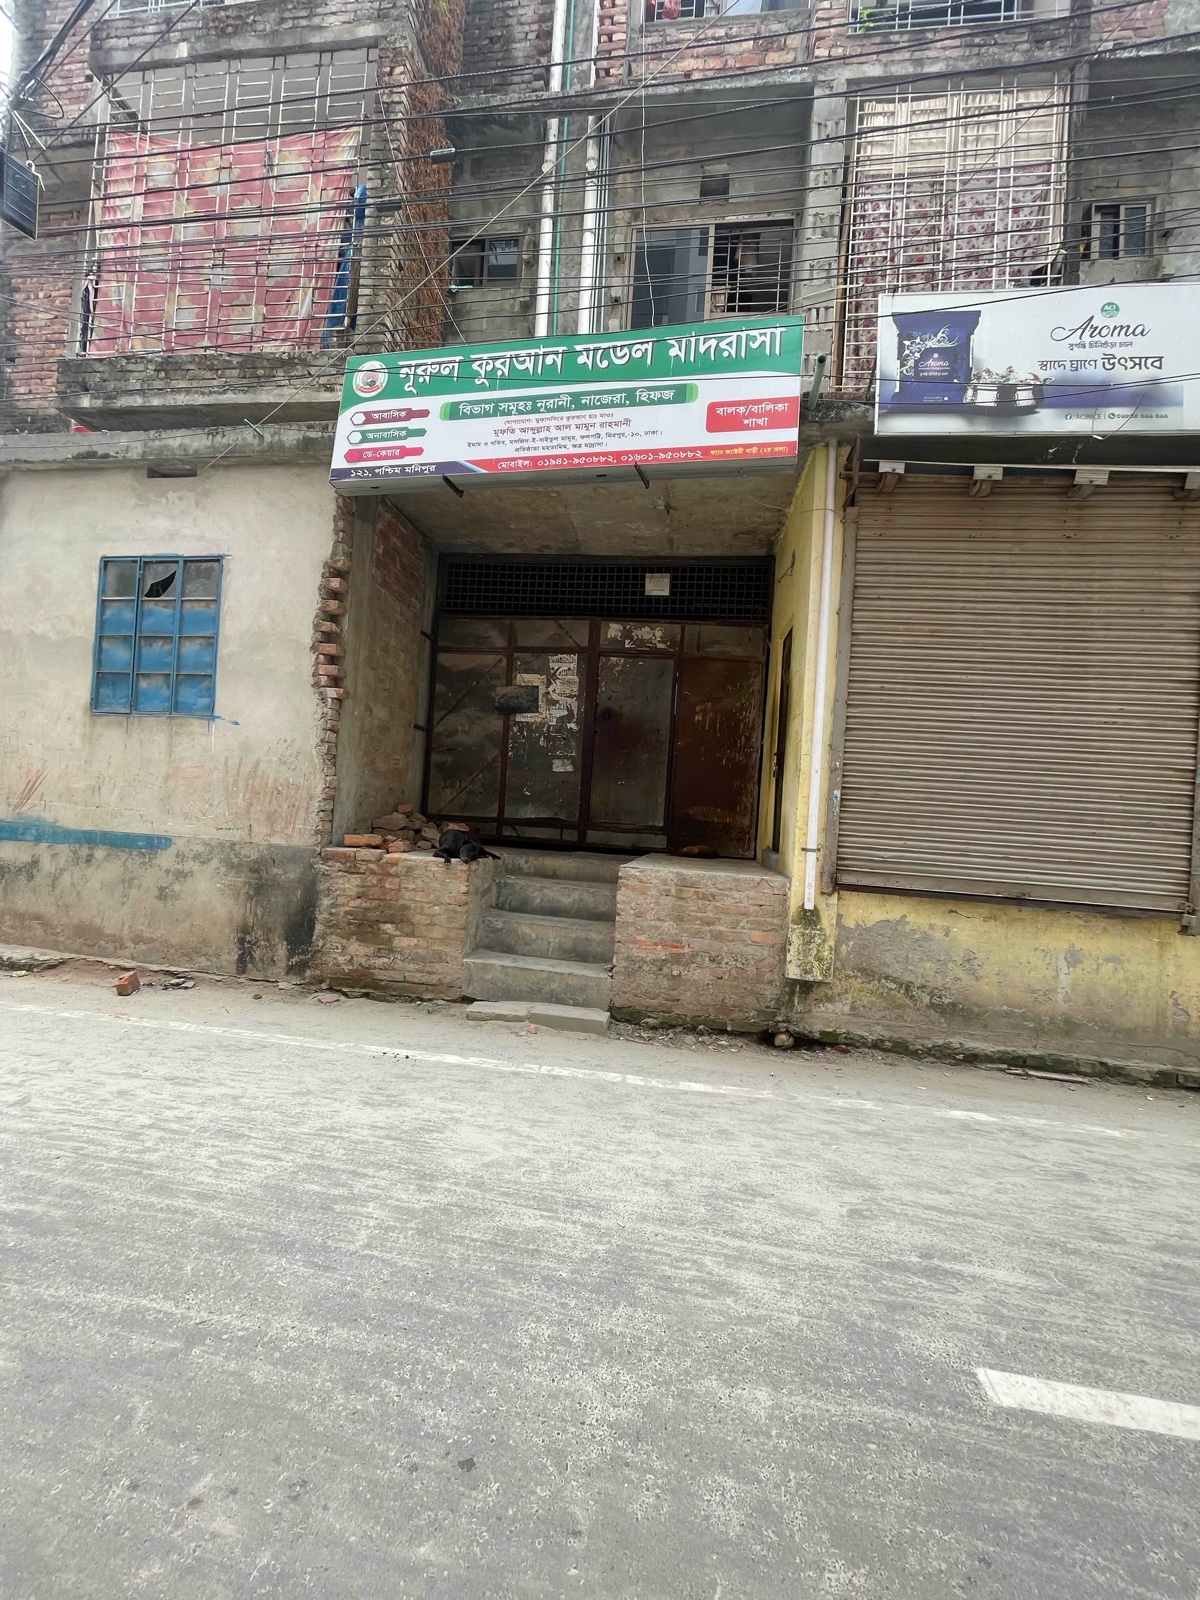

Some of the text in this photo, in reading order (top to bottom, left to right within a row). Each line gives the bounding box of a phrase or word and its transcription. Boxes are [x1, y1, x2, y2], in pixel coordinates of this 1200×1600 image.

[1050, 315, 1151, 341] Aroma
[397, 324, 787, 394] নূরুল কুরআন মডেল মাদরাসা
[1038, 353, 1164, 372] স্বাদে ঘ্রাণে উৎসবে
[459, 402, 495, 416] বিভাগ
[536, 394, 575, 412] নূরানী,
[580, 391, 630, 407] নাজেরা,
[635, 388, 675, 403] হিফজ
[716, 401, 789, 417] বালক/বালিকা
[371, 409, 407, 420] আবাসিক
[742, 417, 769, 427] শাখা
[366, 429, 407, 440] অনাবাসিক
[493, 417, 632, 437] মুফতি আব্দুল্লাহ আল মামুন রাহমানী
[362, 449, 401, 459] ডে-কেয়ার
[350, 463, 436, 478] ১২১, পশ্চিম মনিপুর
